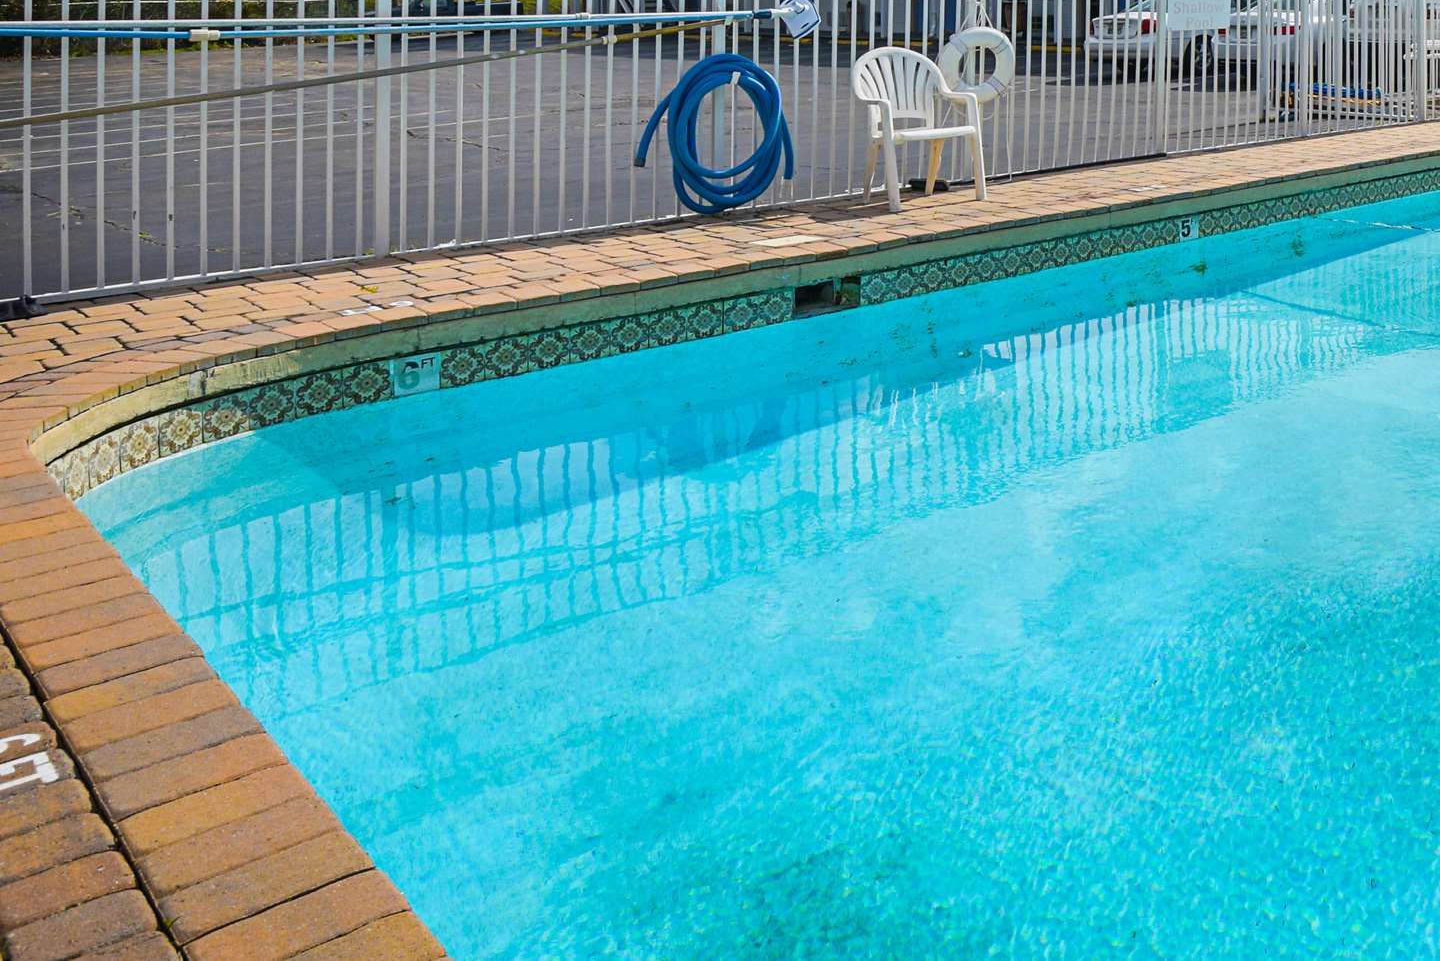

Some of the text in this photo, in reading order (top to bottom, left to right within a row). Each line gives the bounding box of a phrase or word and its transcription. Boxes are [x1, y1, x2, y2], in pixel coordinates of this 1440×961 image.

[1174, 1, 1225, 14] Shallow
[1186, 17, 1214, 29] Pool
[1181, 219, 1191, 238] 5
